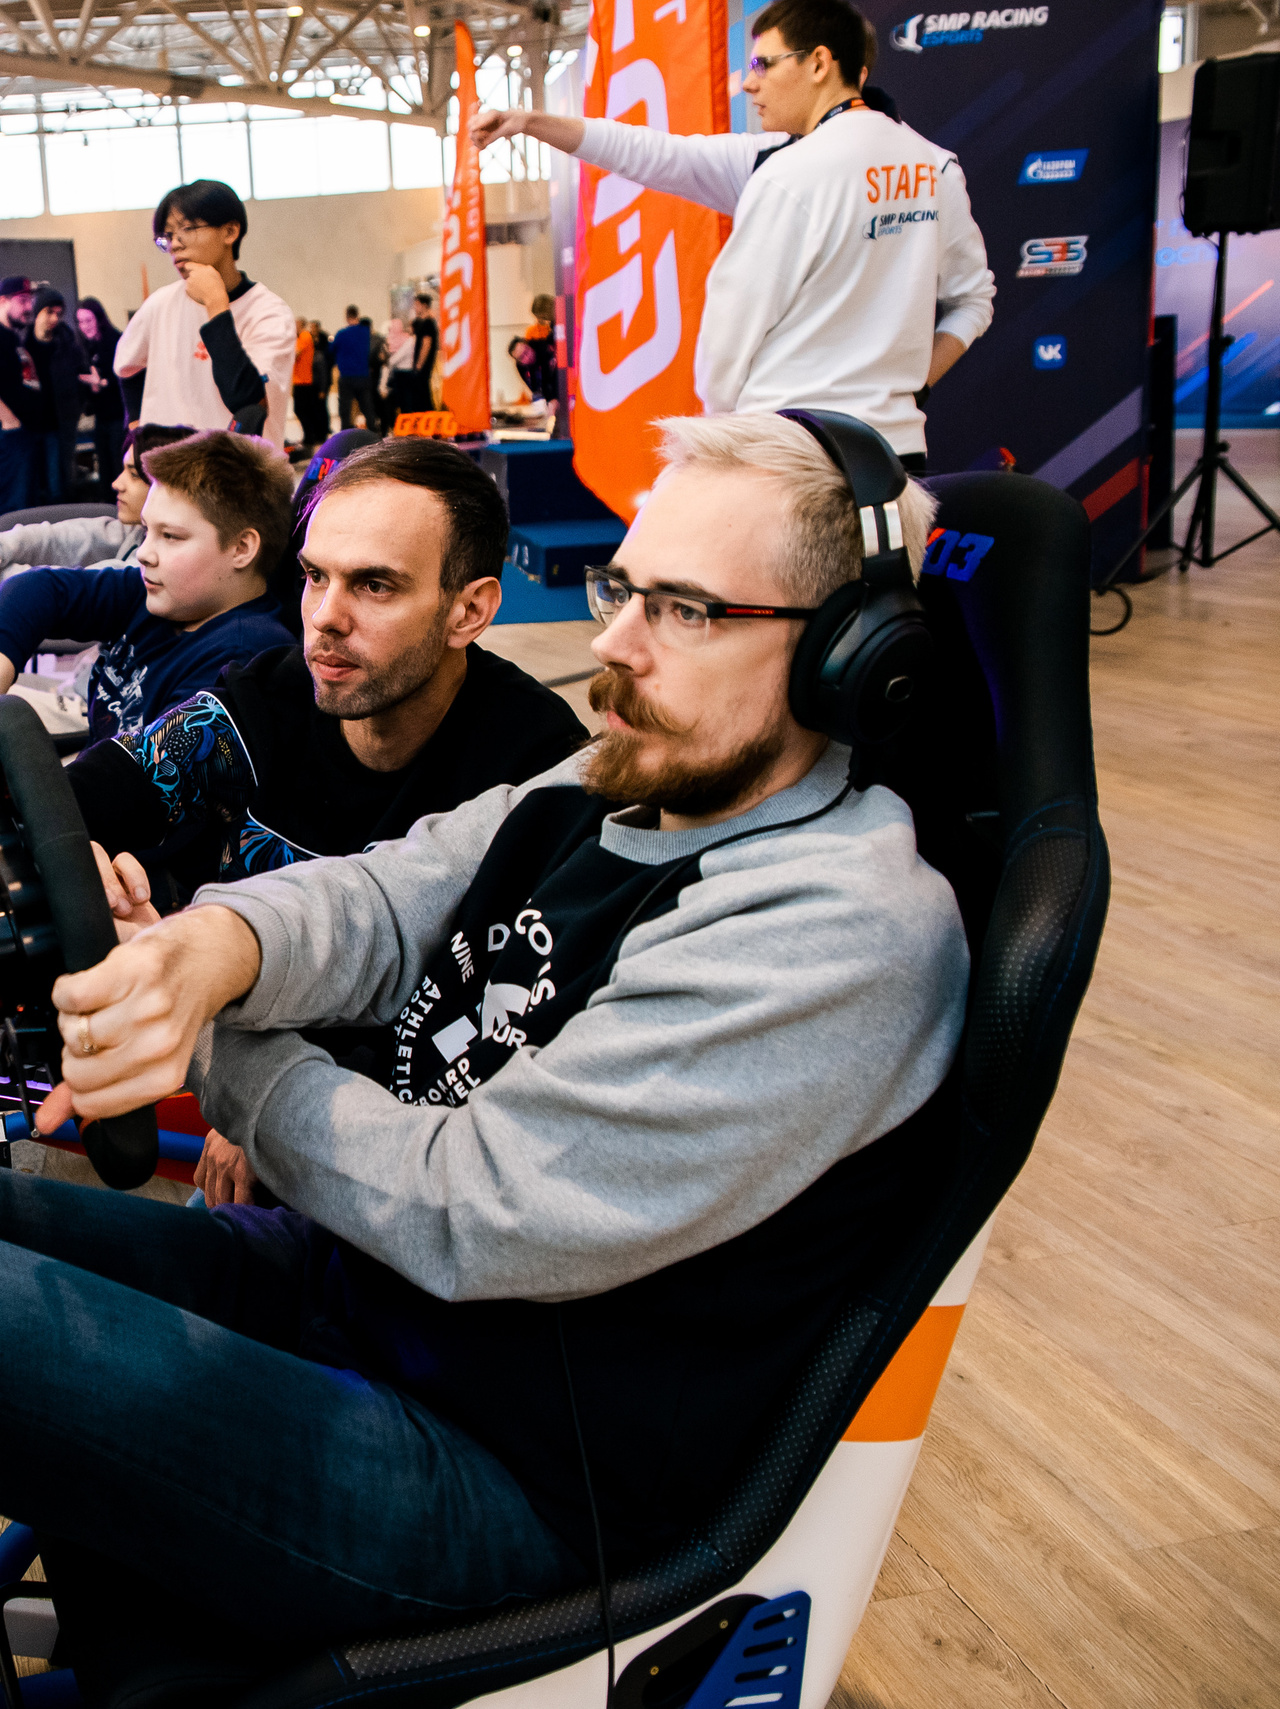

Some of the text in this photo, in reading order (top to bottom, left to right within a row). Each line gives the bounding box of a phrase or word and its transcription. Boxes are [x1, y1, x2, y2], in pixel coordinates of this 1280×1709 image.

[924, 6, 1049, 34] SMP RACING
[866, 163, 937, 204] STAFF
[880, 213, 896, 227] SMP
[921, 527, 995, 582] 03
[450, 931, 475, 984] NINE
[396, 983, 442, 1103] ATHLETIC
